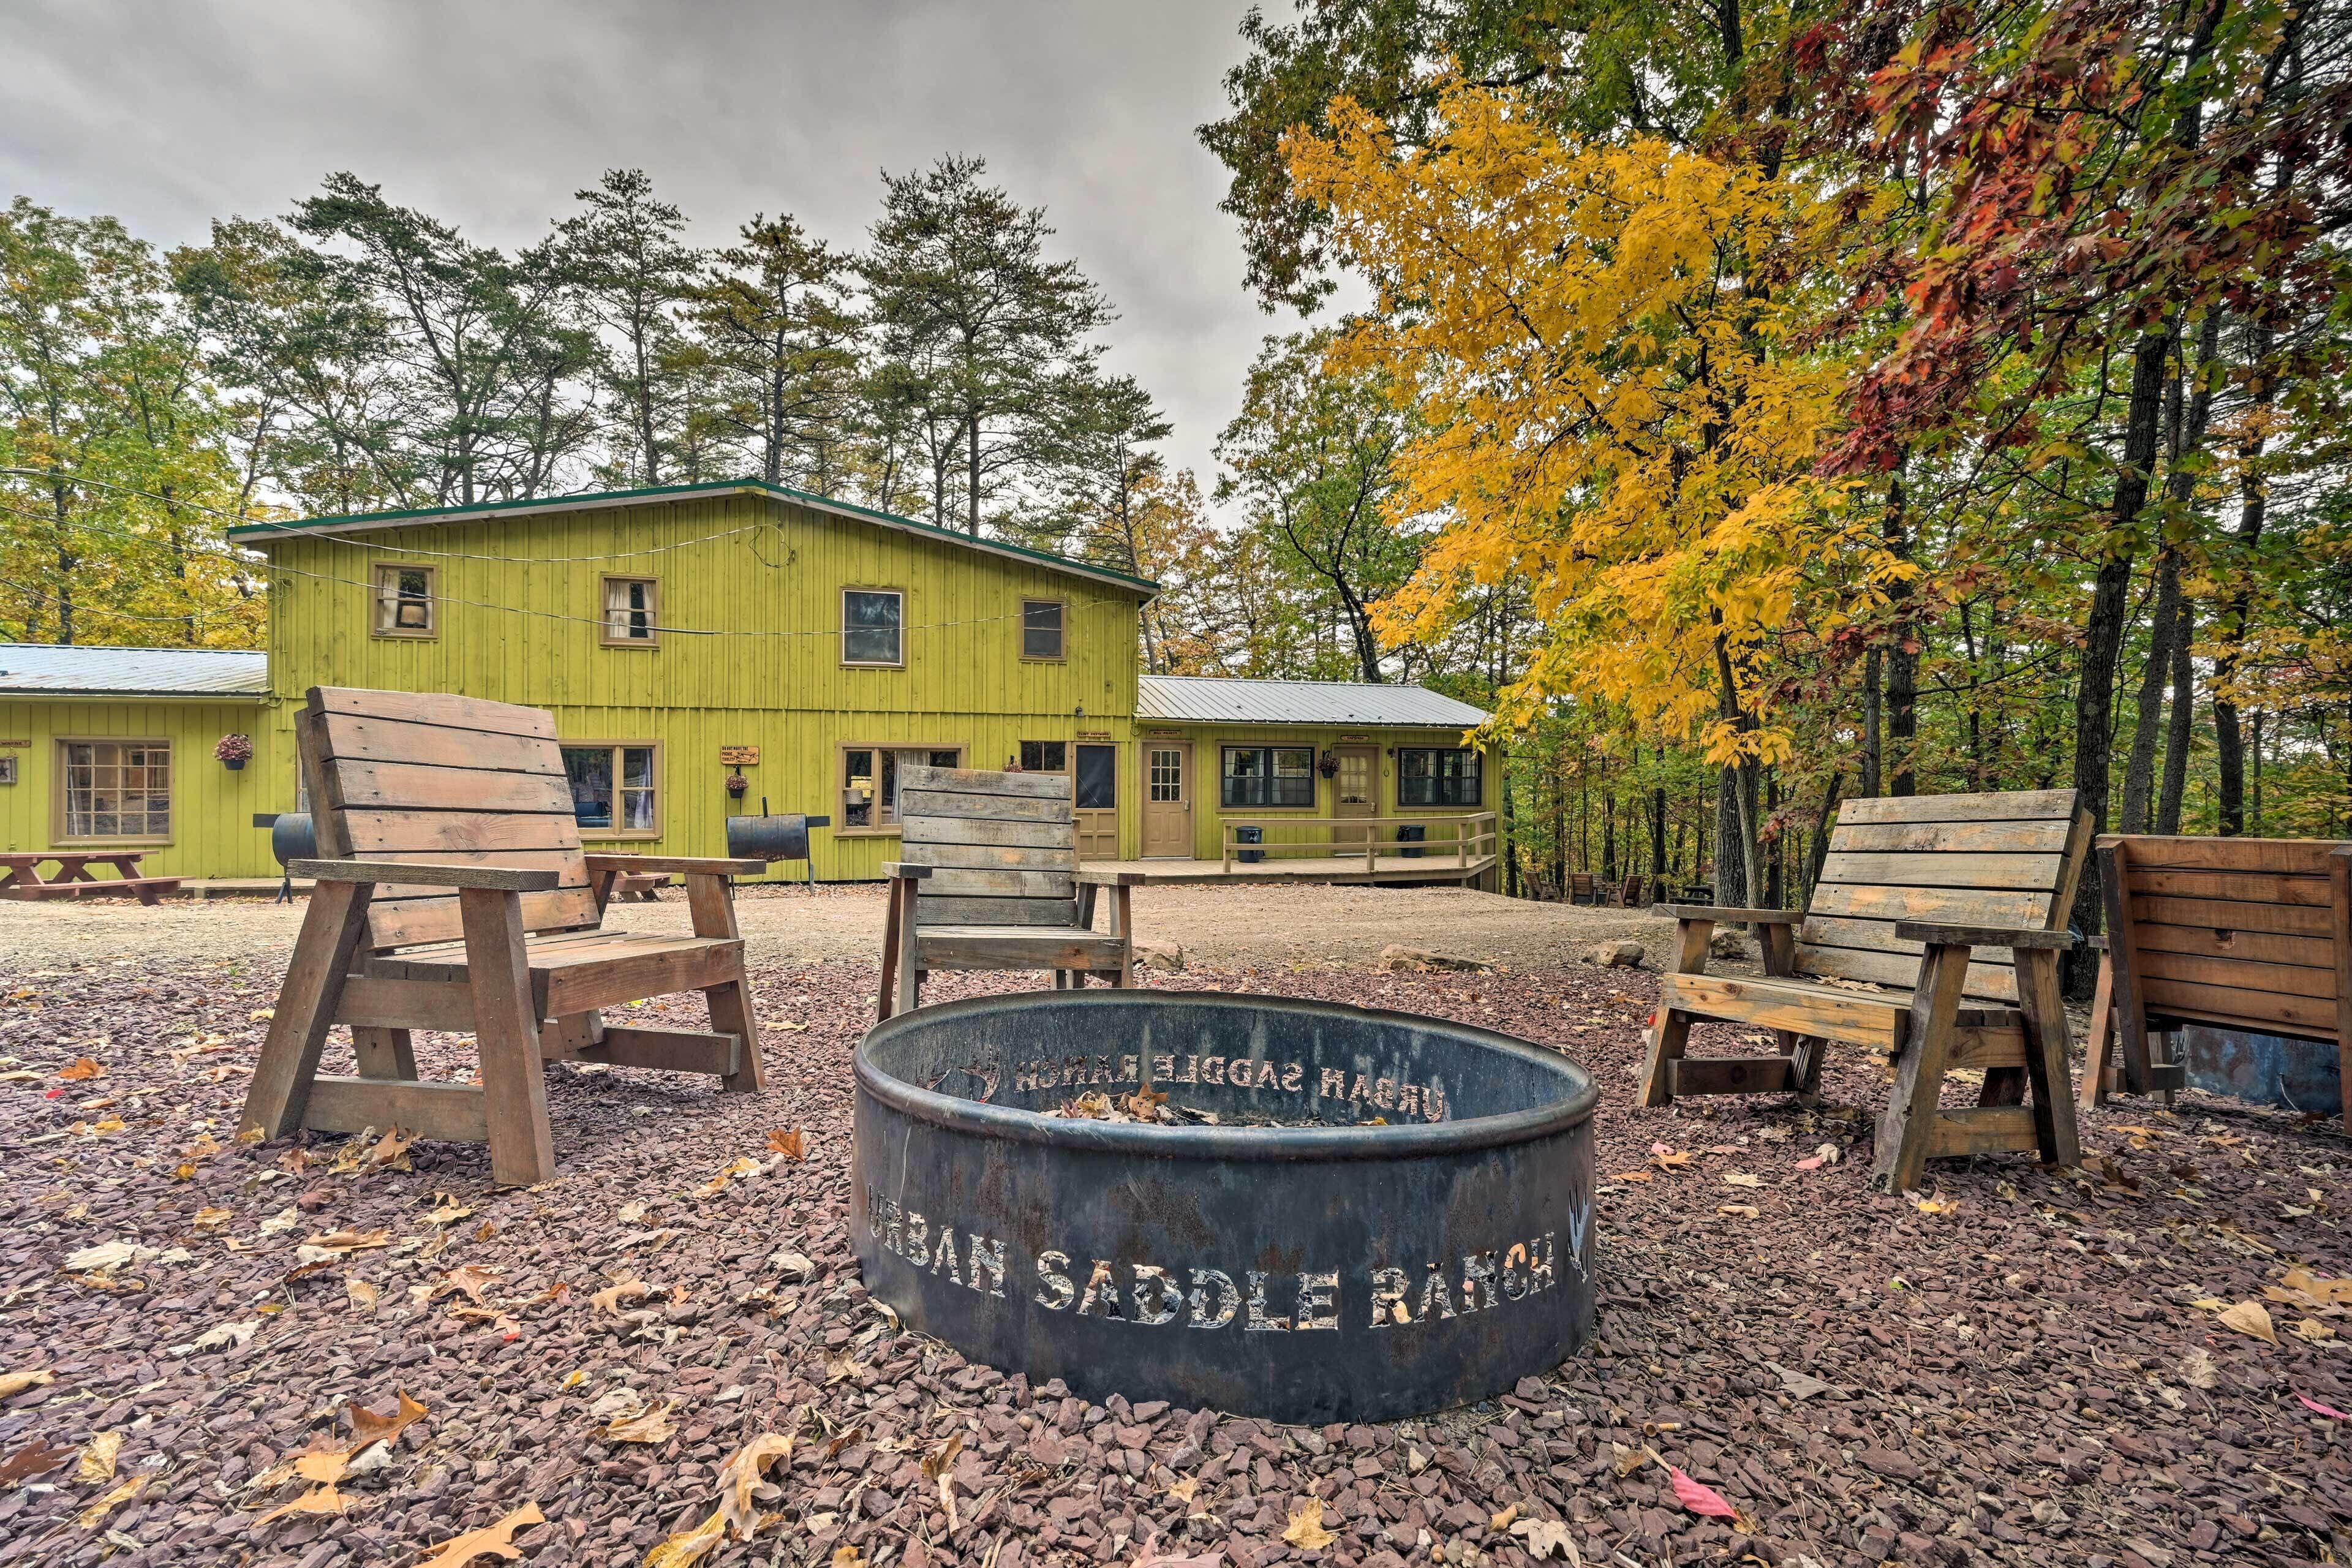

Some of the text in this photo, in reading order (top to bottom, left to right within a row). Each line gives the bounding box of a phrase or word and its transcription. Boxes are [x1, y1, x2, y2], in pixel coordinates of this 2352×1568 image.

[868, 1182, 1556, 1332] URBAN SADDLE RANCH
